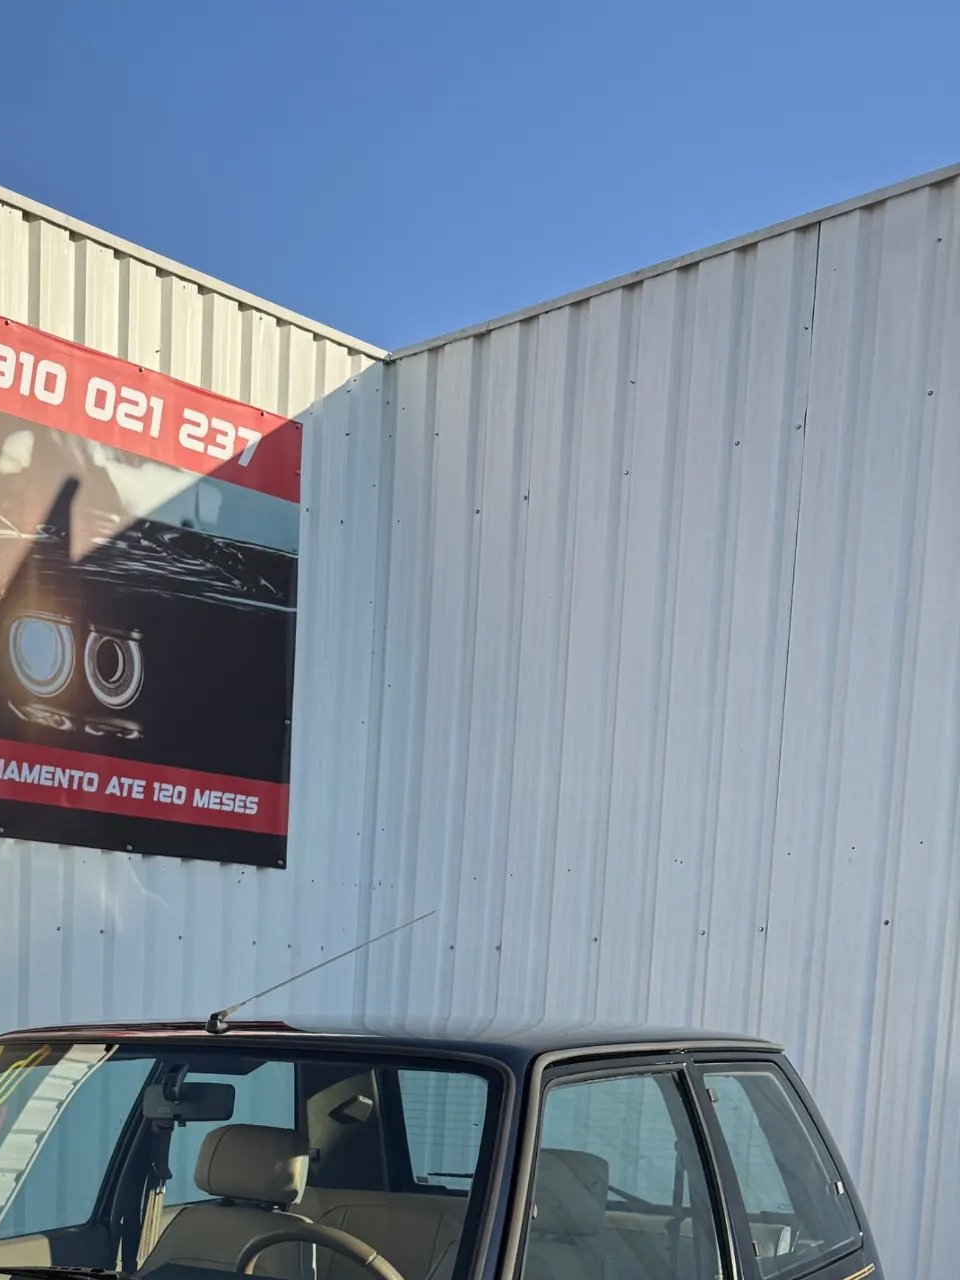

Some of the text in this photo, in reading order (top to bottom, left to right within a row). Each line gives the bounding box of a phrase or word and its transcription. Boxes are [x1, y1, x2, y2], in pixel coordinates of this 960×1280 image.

[85, 378, 164, 438] 021
[179, 409, 262, 467] 237
[105, 776, 145, 799] ATE
[152, 782, 186, 805] 120
[192, 788, 259, 815] MESES
